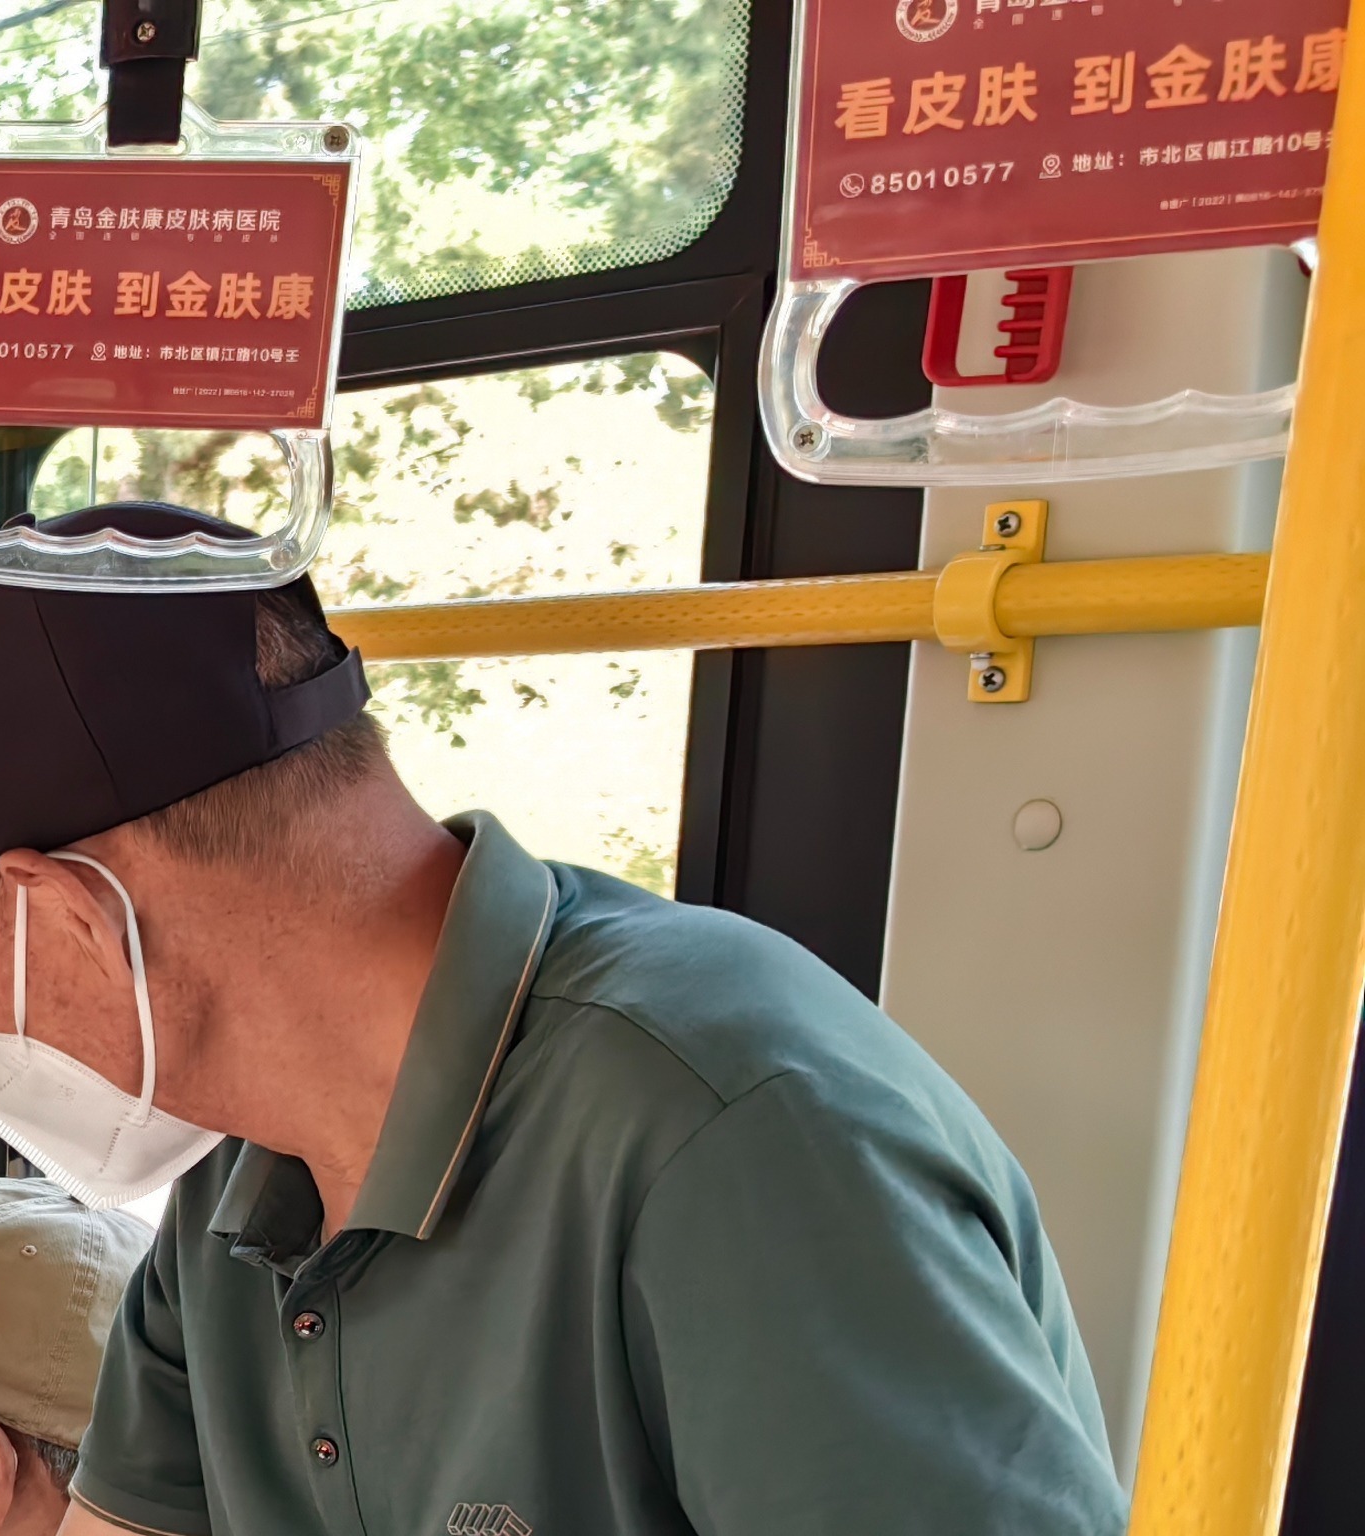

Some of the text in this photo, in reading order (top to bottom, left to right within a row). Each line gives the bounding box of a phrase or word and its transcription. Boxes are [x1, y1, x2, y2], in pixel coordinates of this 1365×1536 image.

[834, 27, 1349, 141] 看皮肤 到金肤康
[870, 161, 1015, 196] 85010577
[49, 206, 282, 233] 青岛金肤康皮肤病医院
[112, 270, 315, 321] 到金肤康
